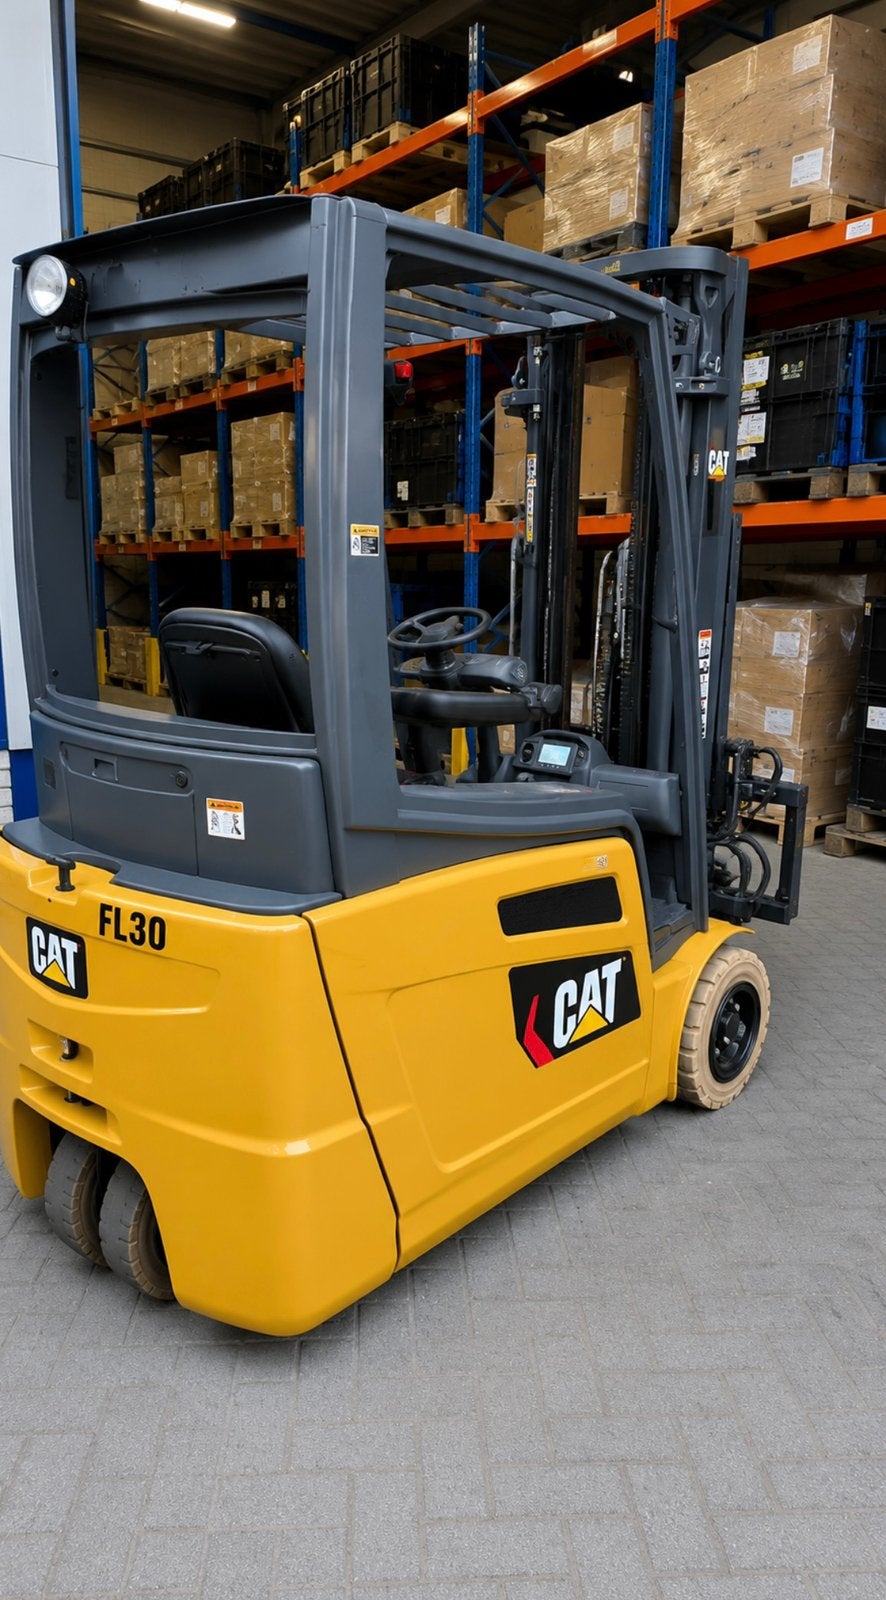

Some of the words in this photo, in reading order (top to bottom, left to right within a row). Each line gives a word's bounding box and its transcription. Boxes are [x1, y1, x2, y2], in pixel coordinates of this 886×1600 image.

[708, 449, 730, 475] CAT
[99, 902, 166, 950] FL30
[31, 925, 78, 989] CAT
[553, 957, 622, 1049] CAT
